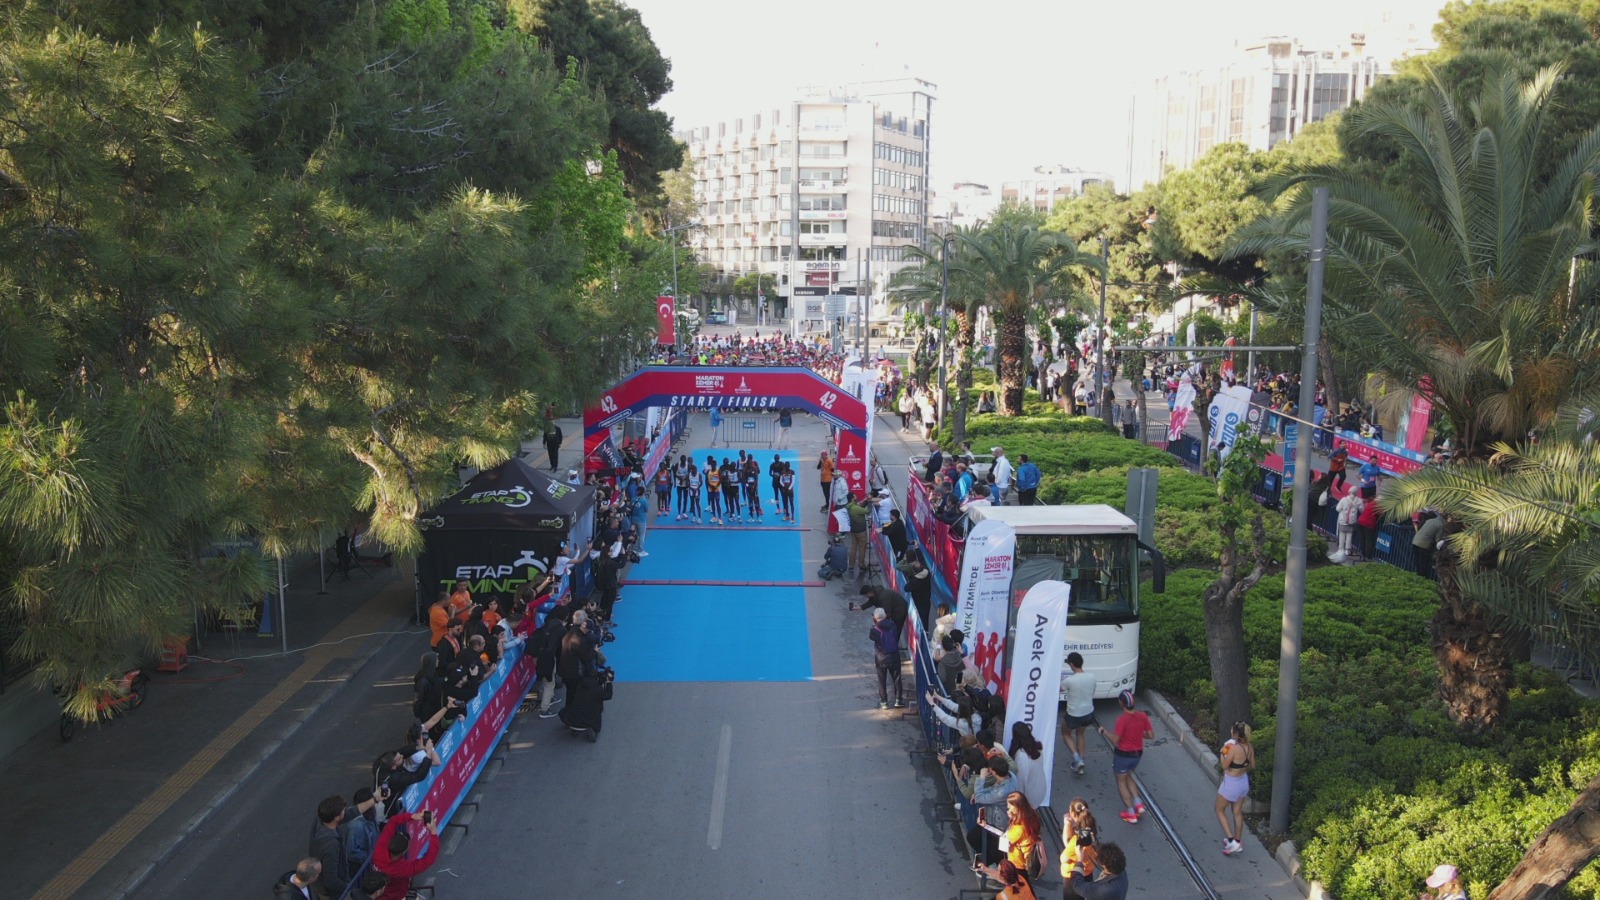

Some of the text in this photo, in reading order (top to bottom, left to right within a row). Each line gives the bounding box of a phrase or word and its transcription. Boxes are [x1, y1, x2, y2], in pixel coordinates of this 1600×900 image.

[601, 395, 618, 414] 42
[671, 395, 778, 407] START / FINISH
[820, 390, 837, 410] 42
[471, 489, 509, 499] ETAP
[460, 497, 516, 505] TIMING
[1376, 536, 1390, 547] POLİS
[984, 555, 1012, 563] MARATON
[455, 564, 513, 579] ETAP
[440, 578, 527, 593] TMING
[963, 565, 980, 639] AVEK İZMİR'DE
[1031, 613, 1049, 661] Avek
[1079, 642, 1114, 650] BELEDİYESİ
